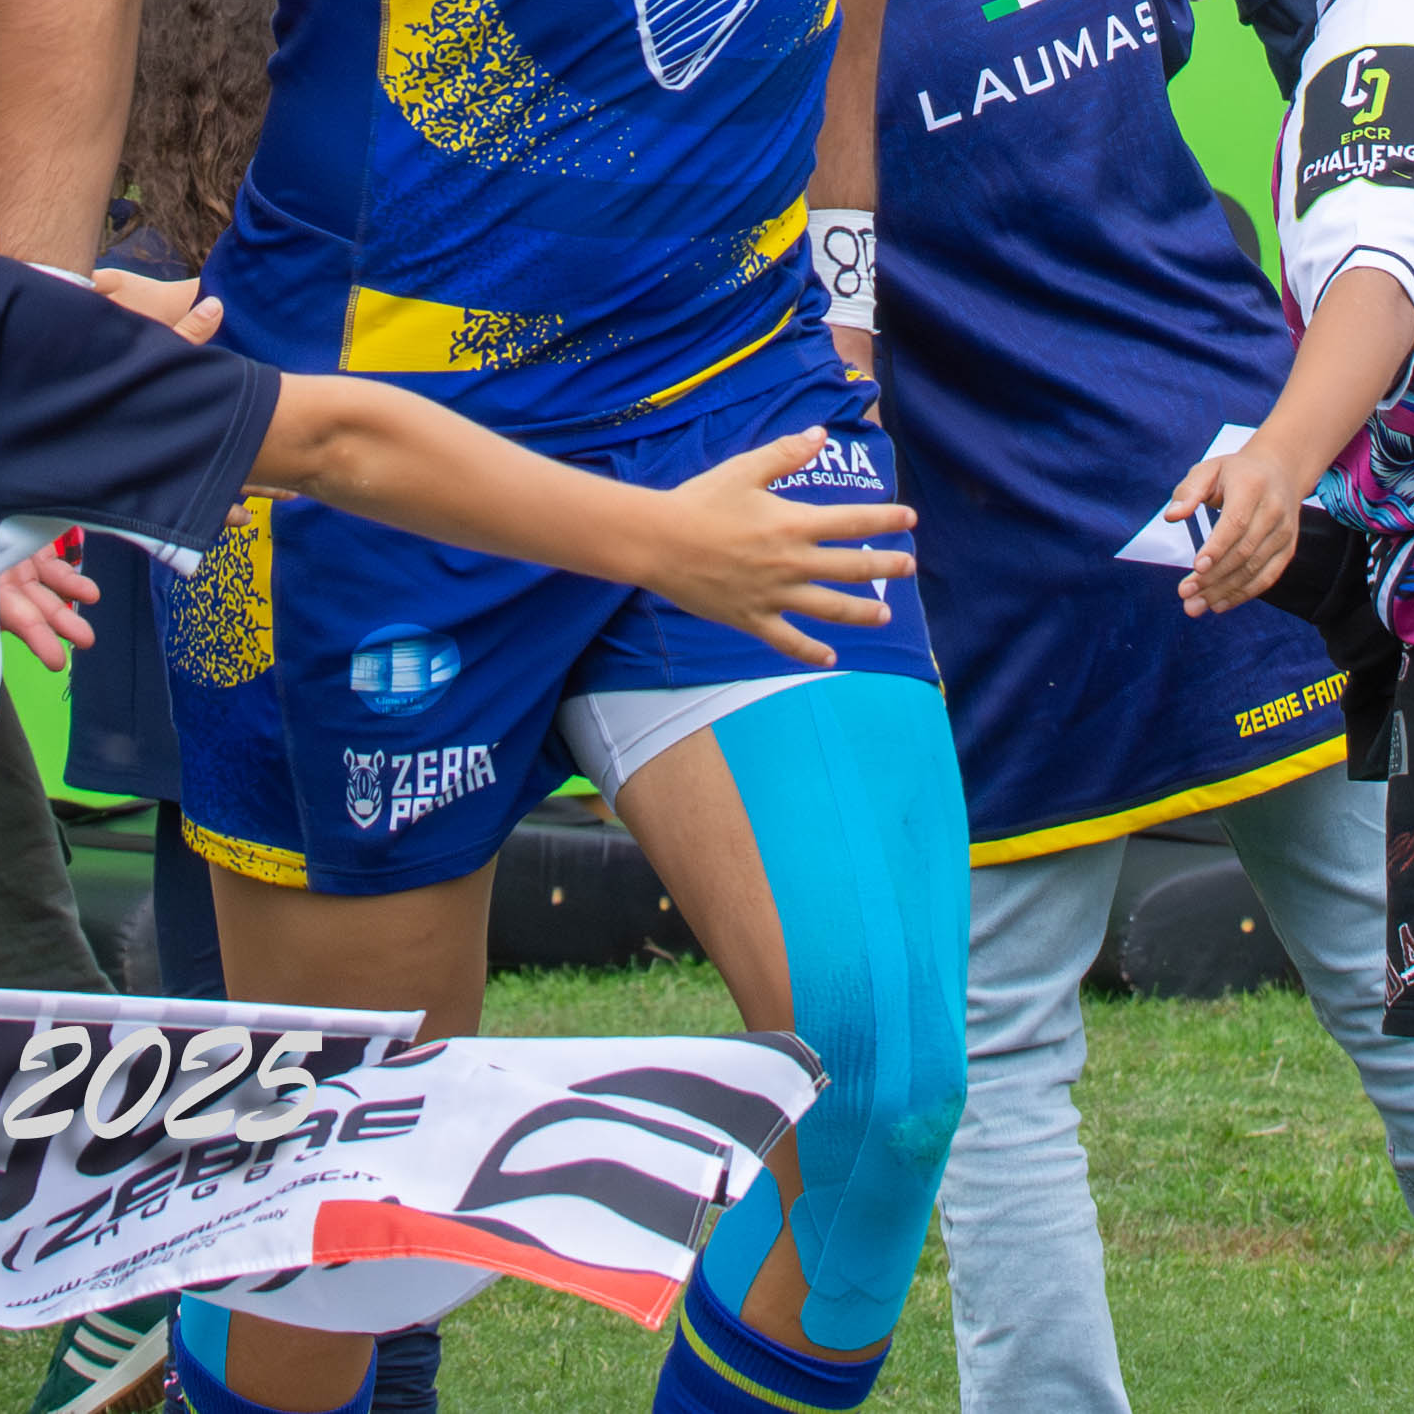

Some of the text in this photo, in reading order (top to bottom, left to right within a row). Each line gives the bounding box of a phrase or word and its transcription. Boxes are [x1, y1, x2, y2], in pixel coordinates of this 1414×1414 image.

[917, 0, 1159, 132] LAUMAS
[1340, 126, 1392, 146] EPCR
[811, 471, 885, 491] SOLUTIONS
[1234, 670, 1351, 738] ZEBRE FAM
